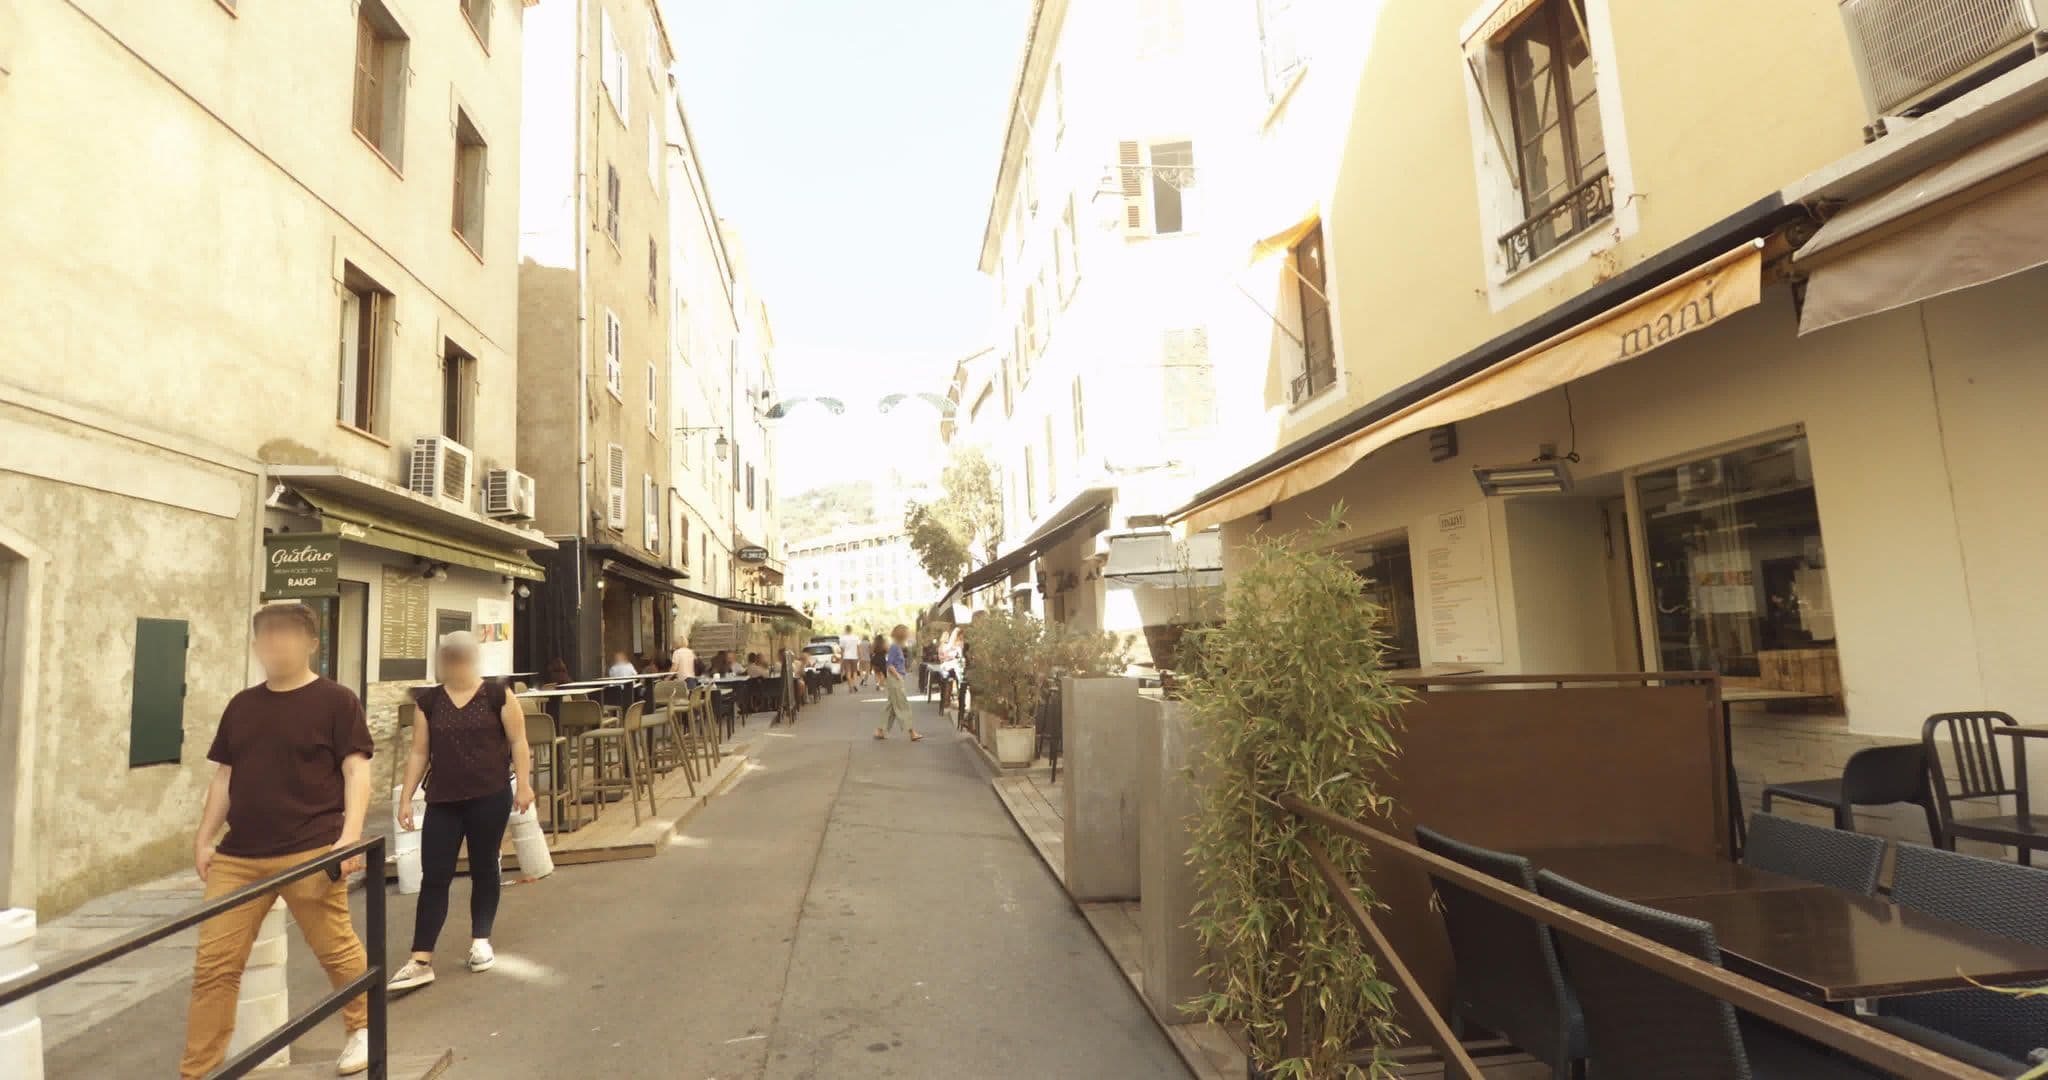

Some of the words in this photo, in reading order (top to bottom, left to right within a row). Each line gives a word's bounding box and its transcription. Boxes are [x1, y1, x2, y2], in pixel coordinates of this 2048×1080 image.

[1619, 279, 1719, 358] mani
[271, 545, 333, 568] Gustino
[288, 577, 317, 587] RAUGI
